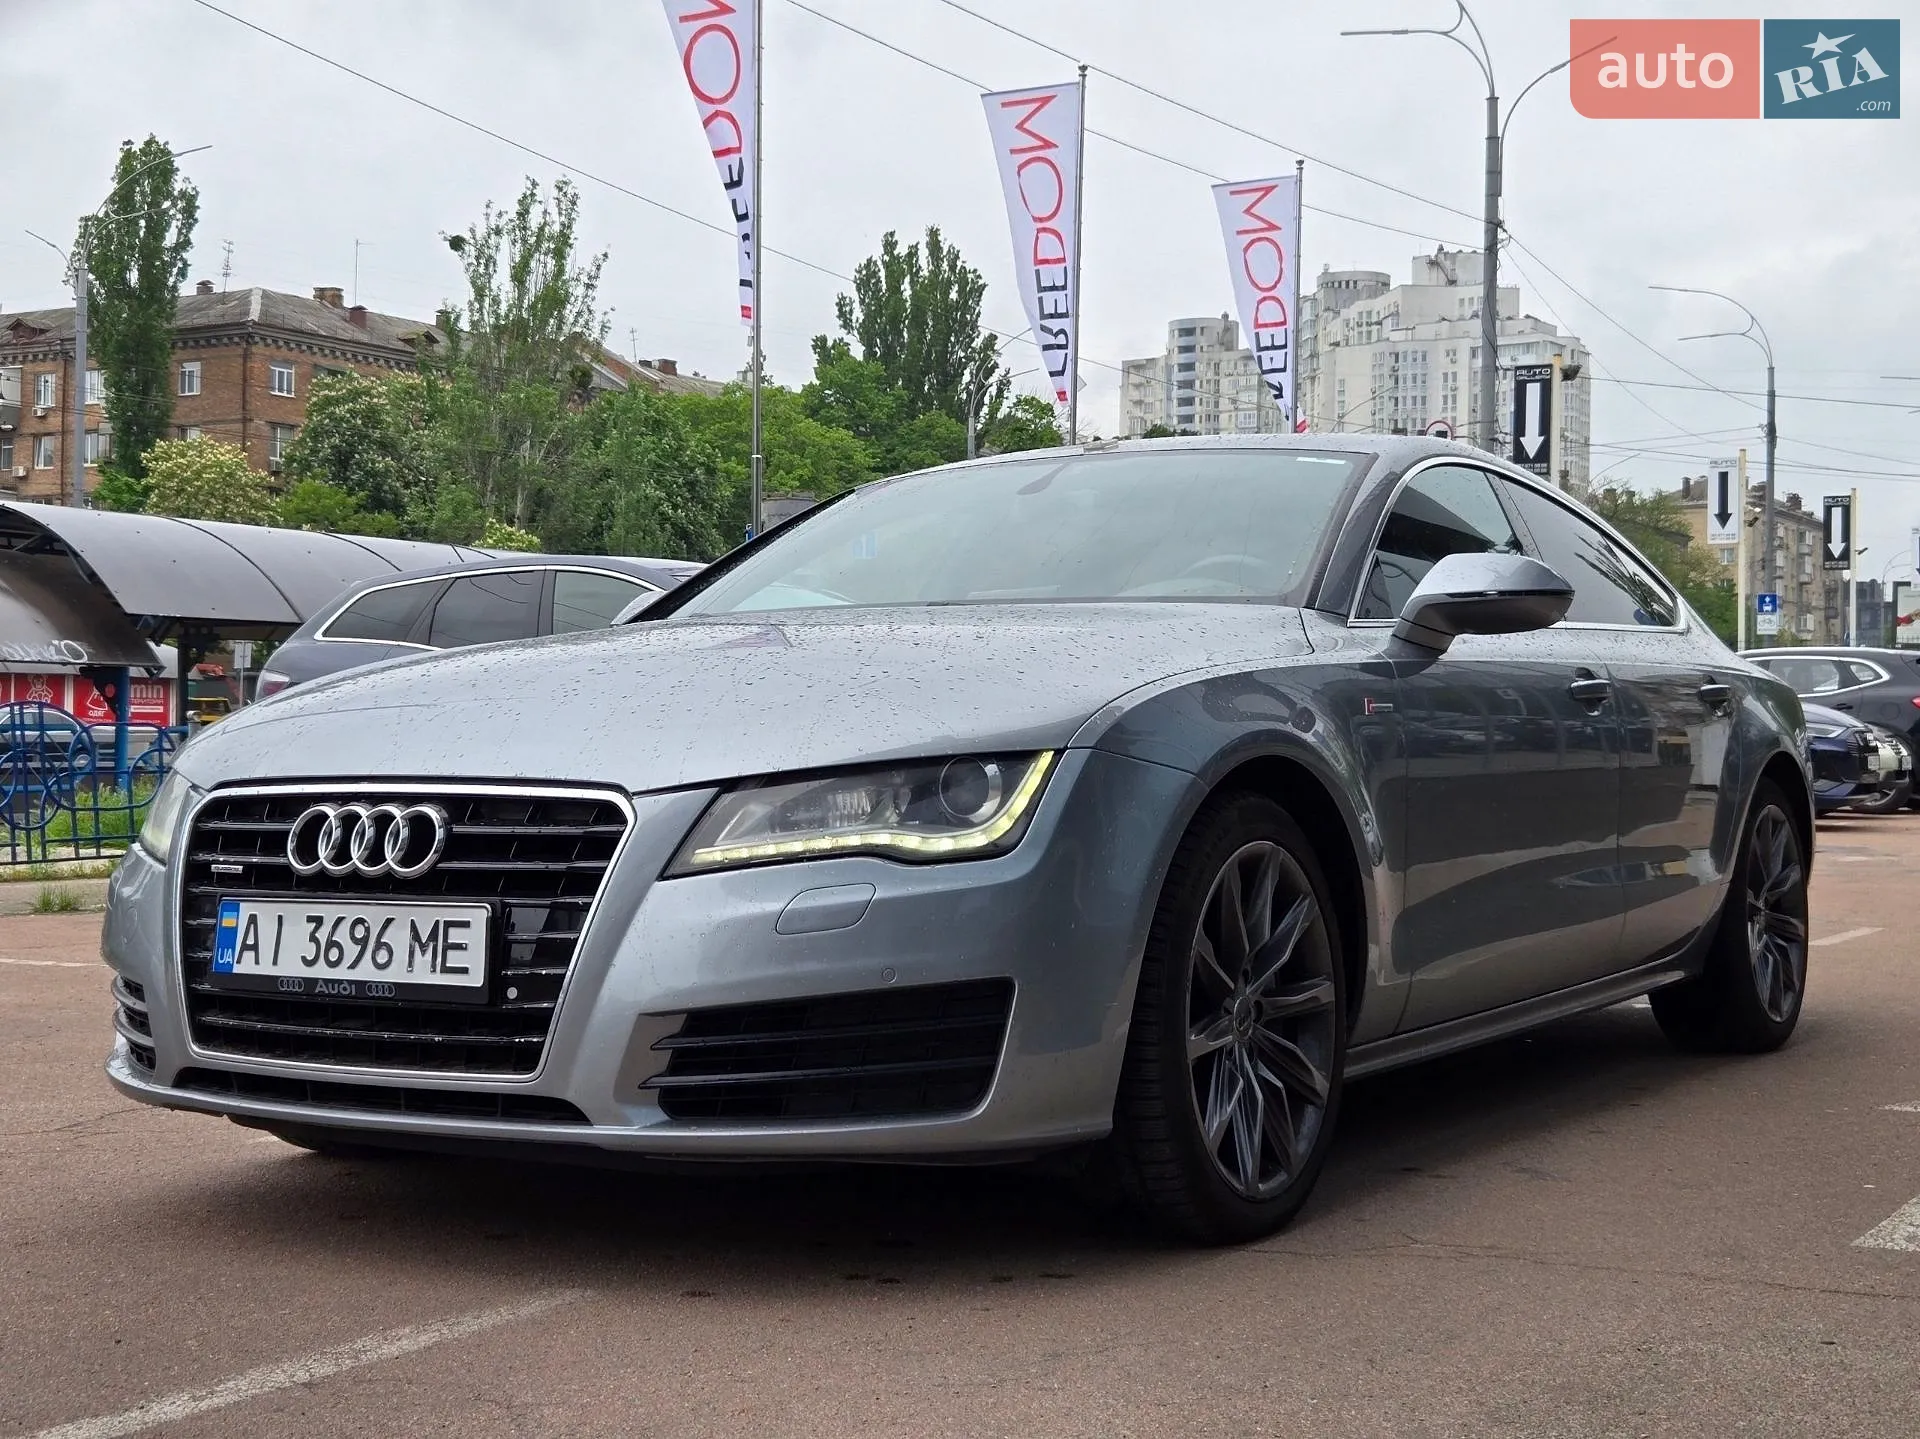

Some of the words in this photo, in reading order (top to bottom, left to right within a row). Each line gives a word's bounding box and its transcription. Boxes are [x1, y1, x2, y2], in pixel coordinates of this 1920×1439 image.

[1516, 368, 1551, 376] AUTO
[235, 912, 284, 966] AI
[300, 914, 397, 970] 3696
[406, 917, 472, 975] ME
[217, 949, 233, 965] UA
[314, 979, 356, 997] Audi
